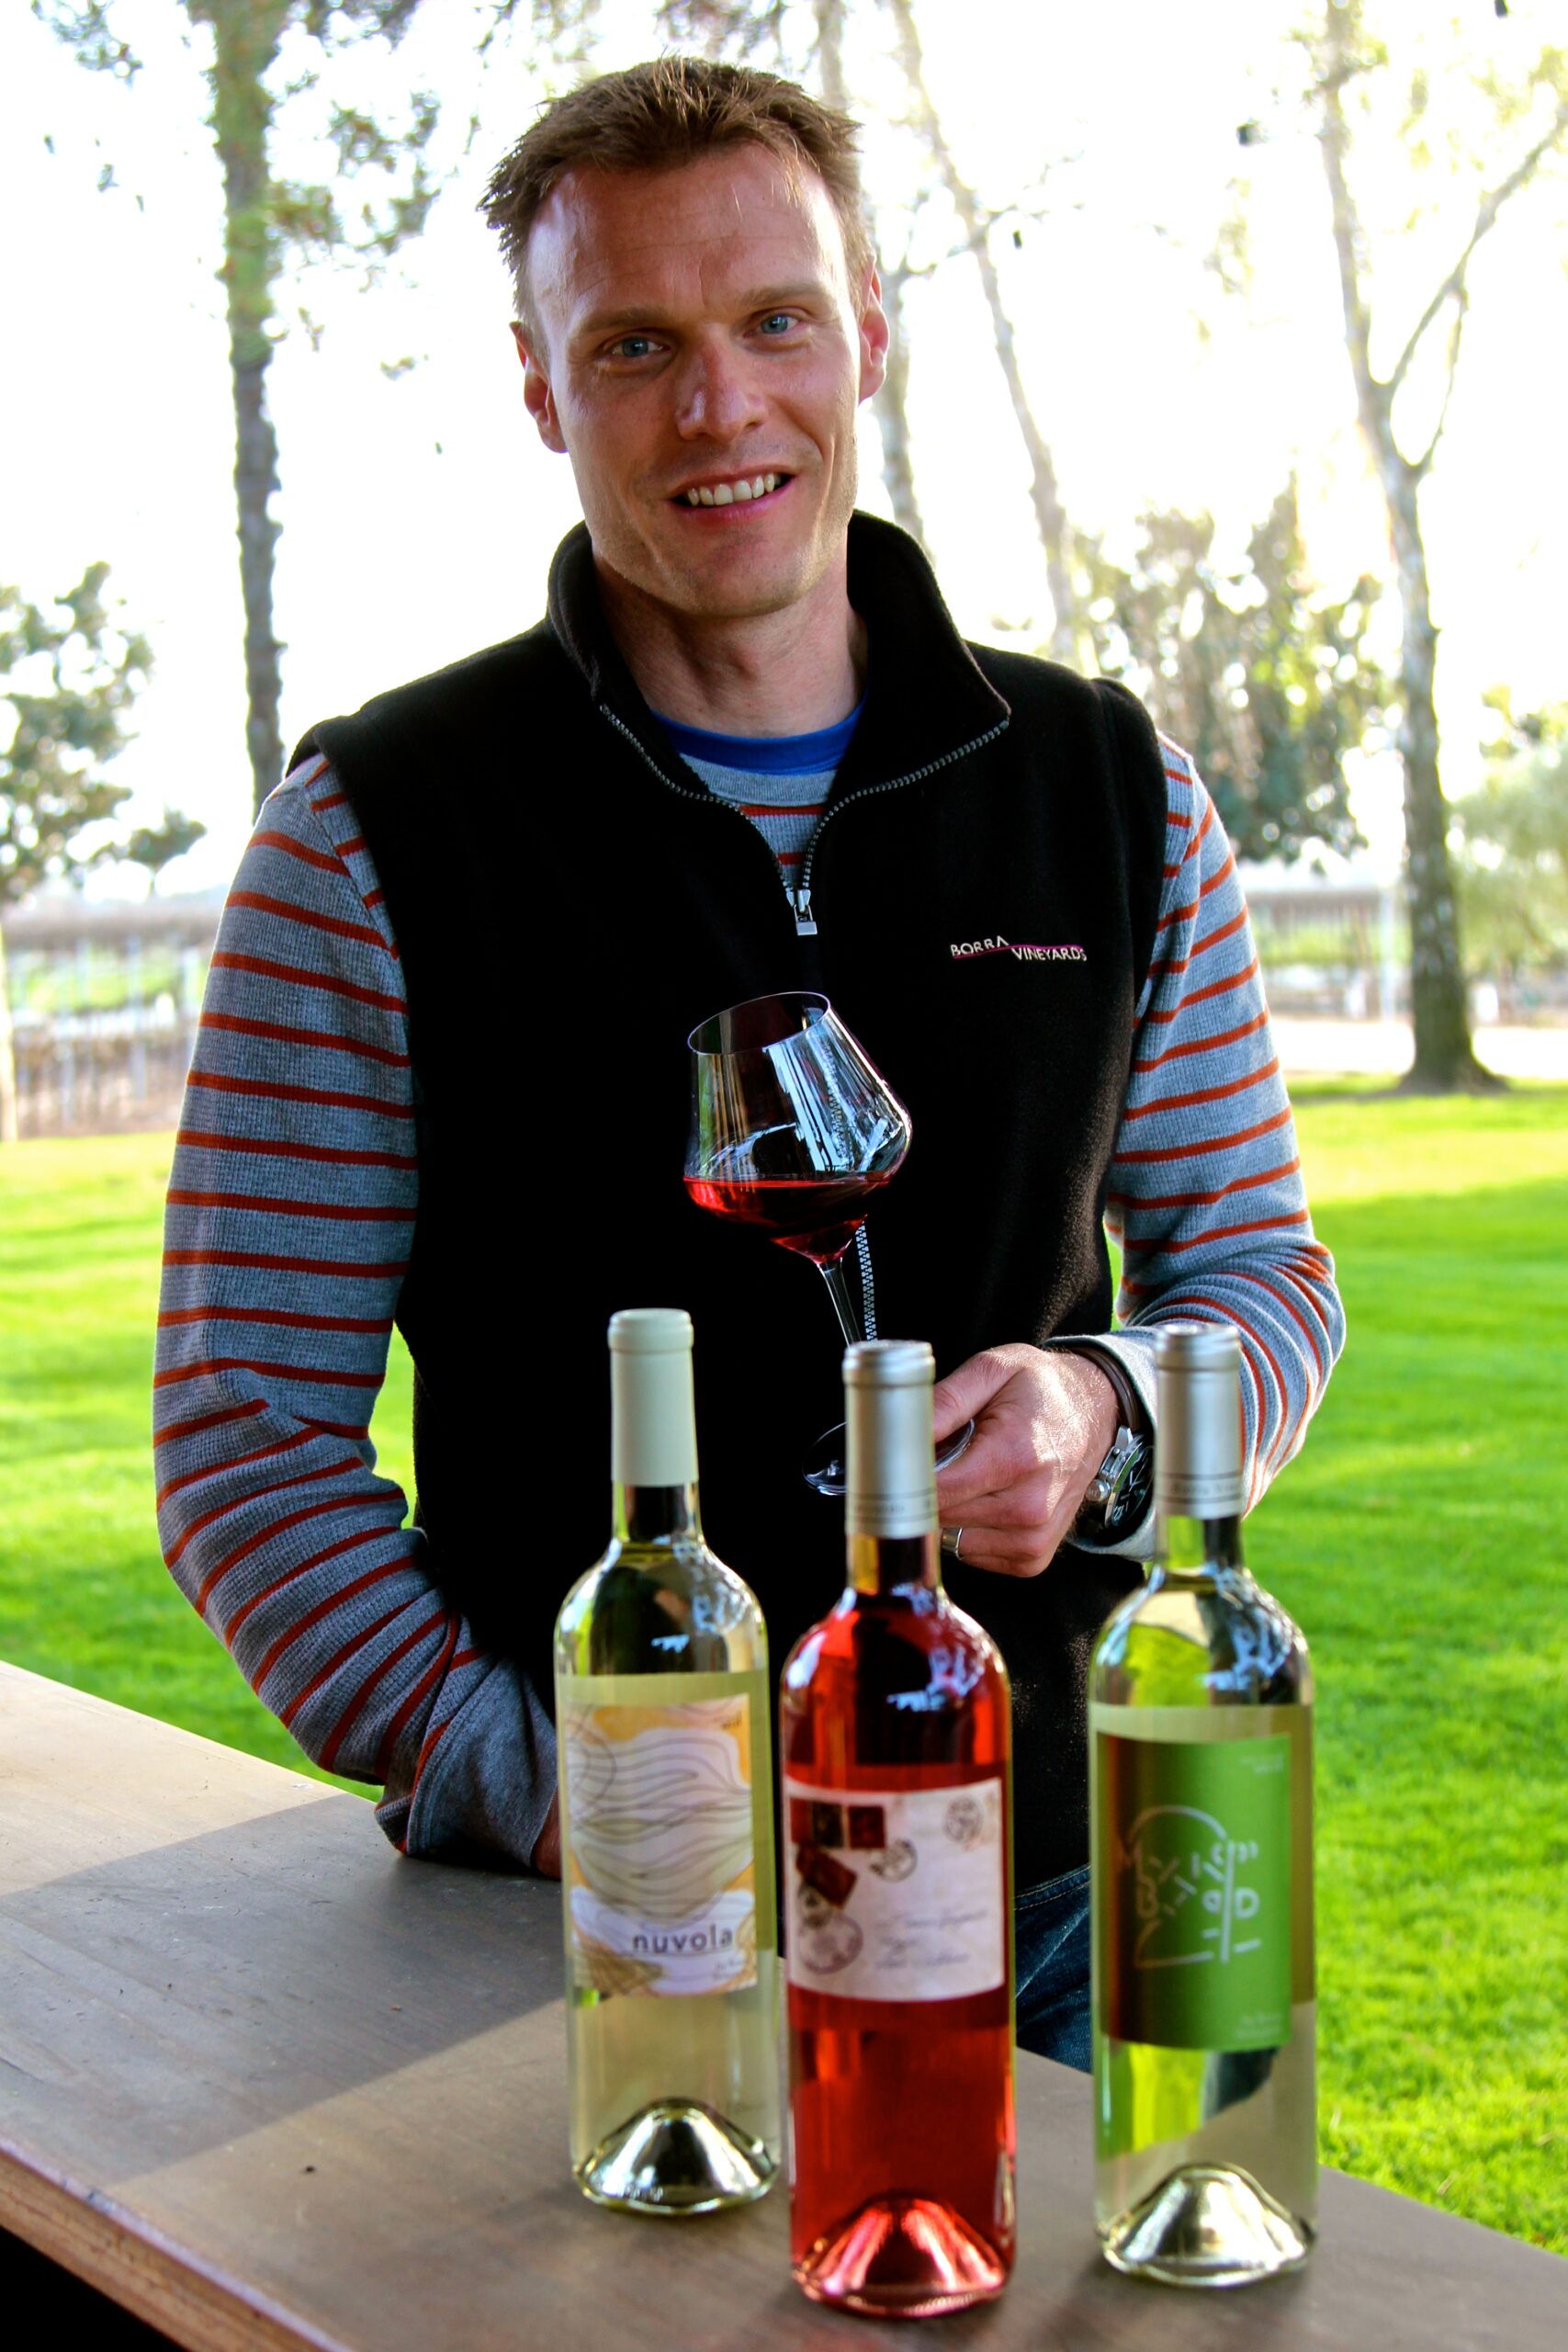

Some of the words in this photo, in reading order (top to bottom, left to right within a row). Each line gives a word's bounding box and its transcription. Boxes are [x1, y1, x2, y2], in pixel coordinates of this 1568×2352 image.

[950, 934, 1010, 956] BORRA
[1011, 947, 1088, 962] VINEYARDS
[632, 1924, 733, 1953] nuvola
